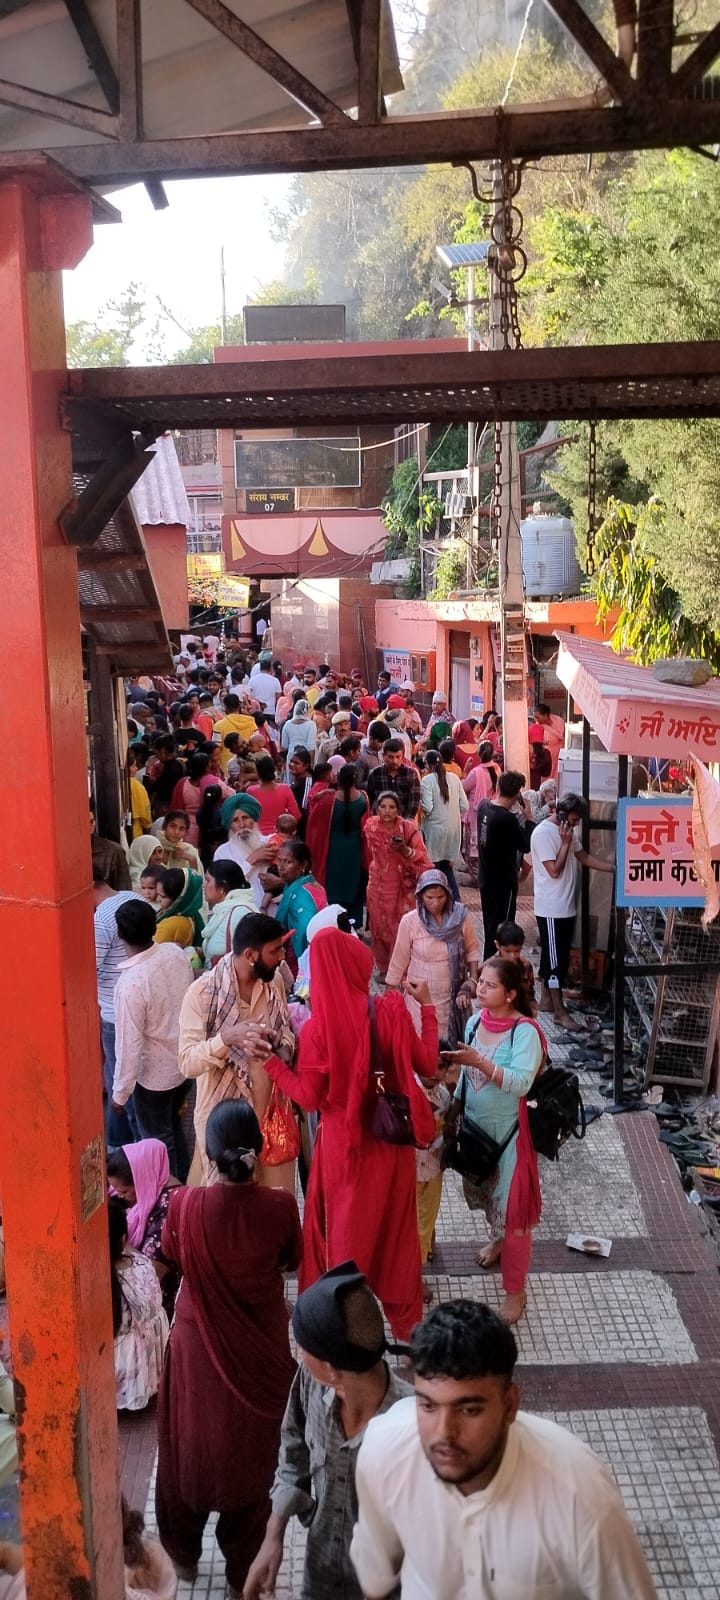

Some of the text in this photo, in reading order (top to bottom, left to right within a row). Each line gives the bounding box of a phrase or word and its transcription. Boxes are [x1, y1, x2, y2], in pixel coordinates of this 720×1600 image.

[264, 503, 275, 511] 07
[639, 710, 720, 746] ਜੀ ਆਇ
[626, 809, 680, 857] जूते
[628, 859, 666, 882] जमा
